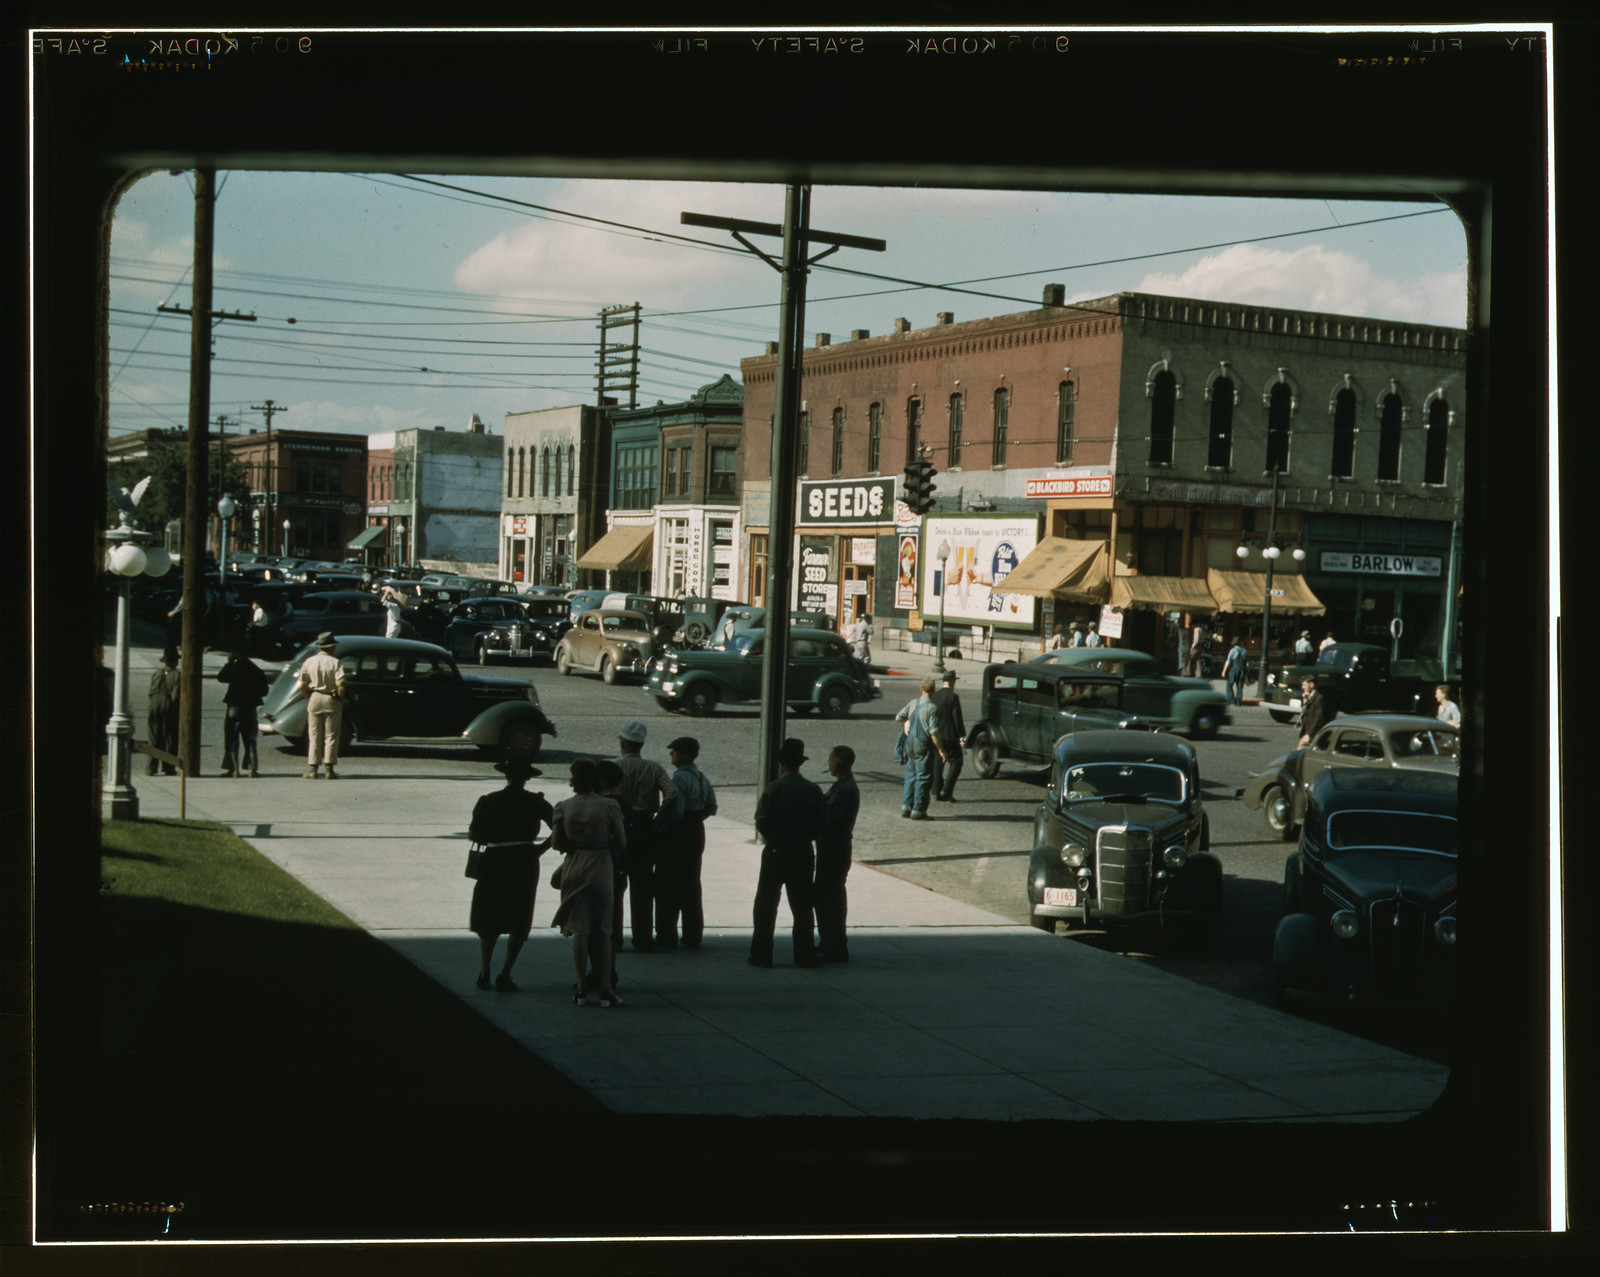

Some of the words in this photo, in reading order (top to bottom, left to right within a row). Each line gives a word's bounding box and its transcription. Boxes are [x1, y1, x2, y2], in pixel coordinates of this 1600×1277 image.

[1036, 480, 1075, 494] BLACKBIRD
[1076, 479, 1100, 493] STORE
[808, 485, 884, 518] SEEDS
[1352, 555, 1415, 571] BARLOW
[804, 566, 826, 582] SEED
[802, 583, 828, 594] STORE
